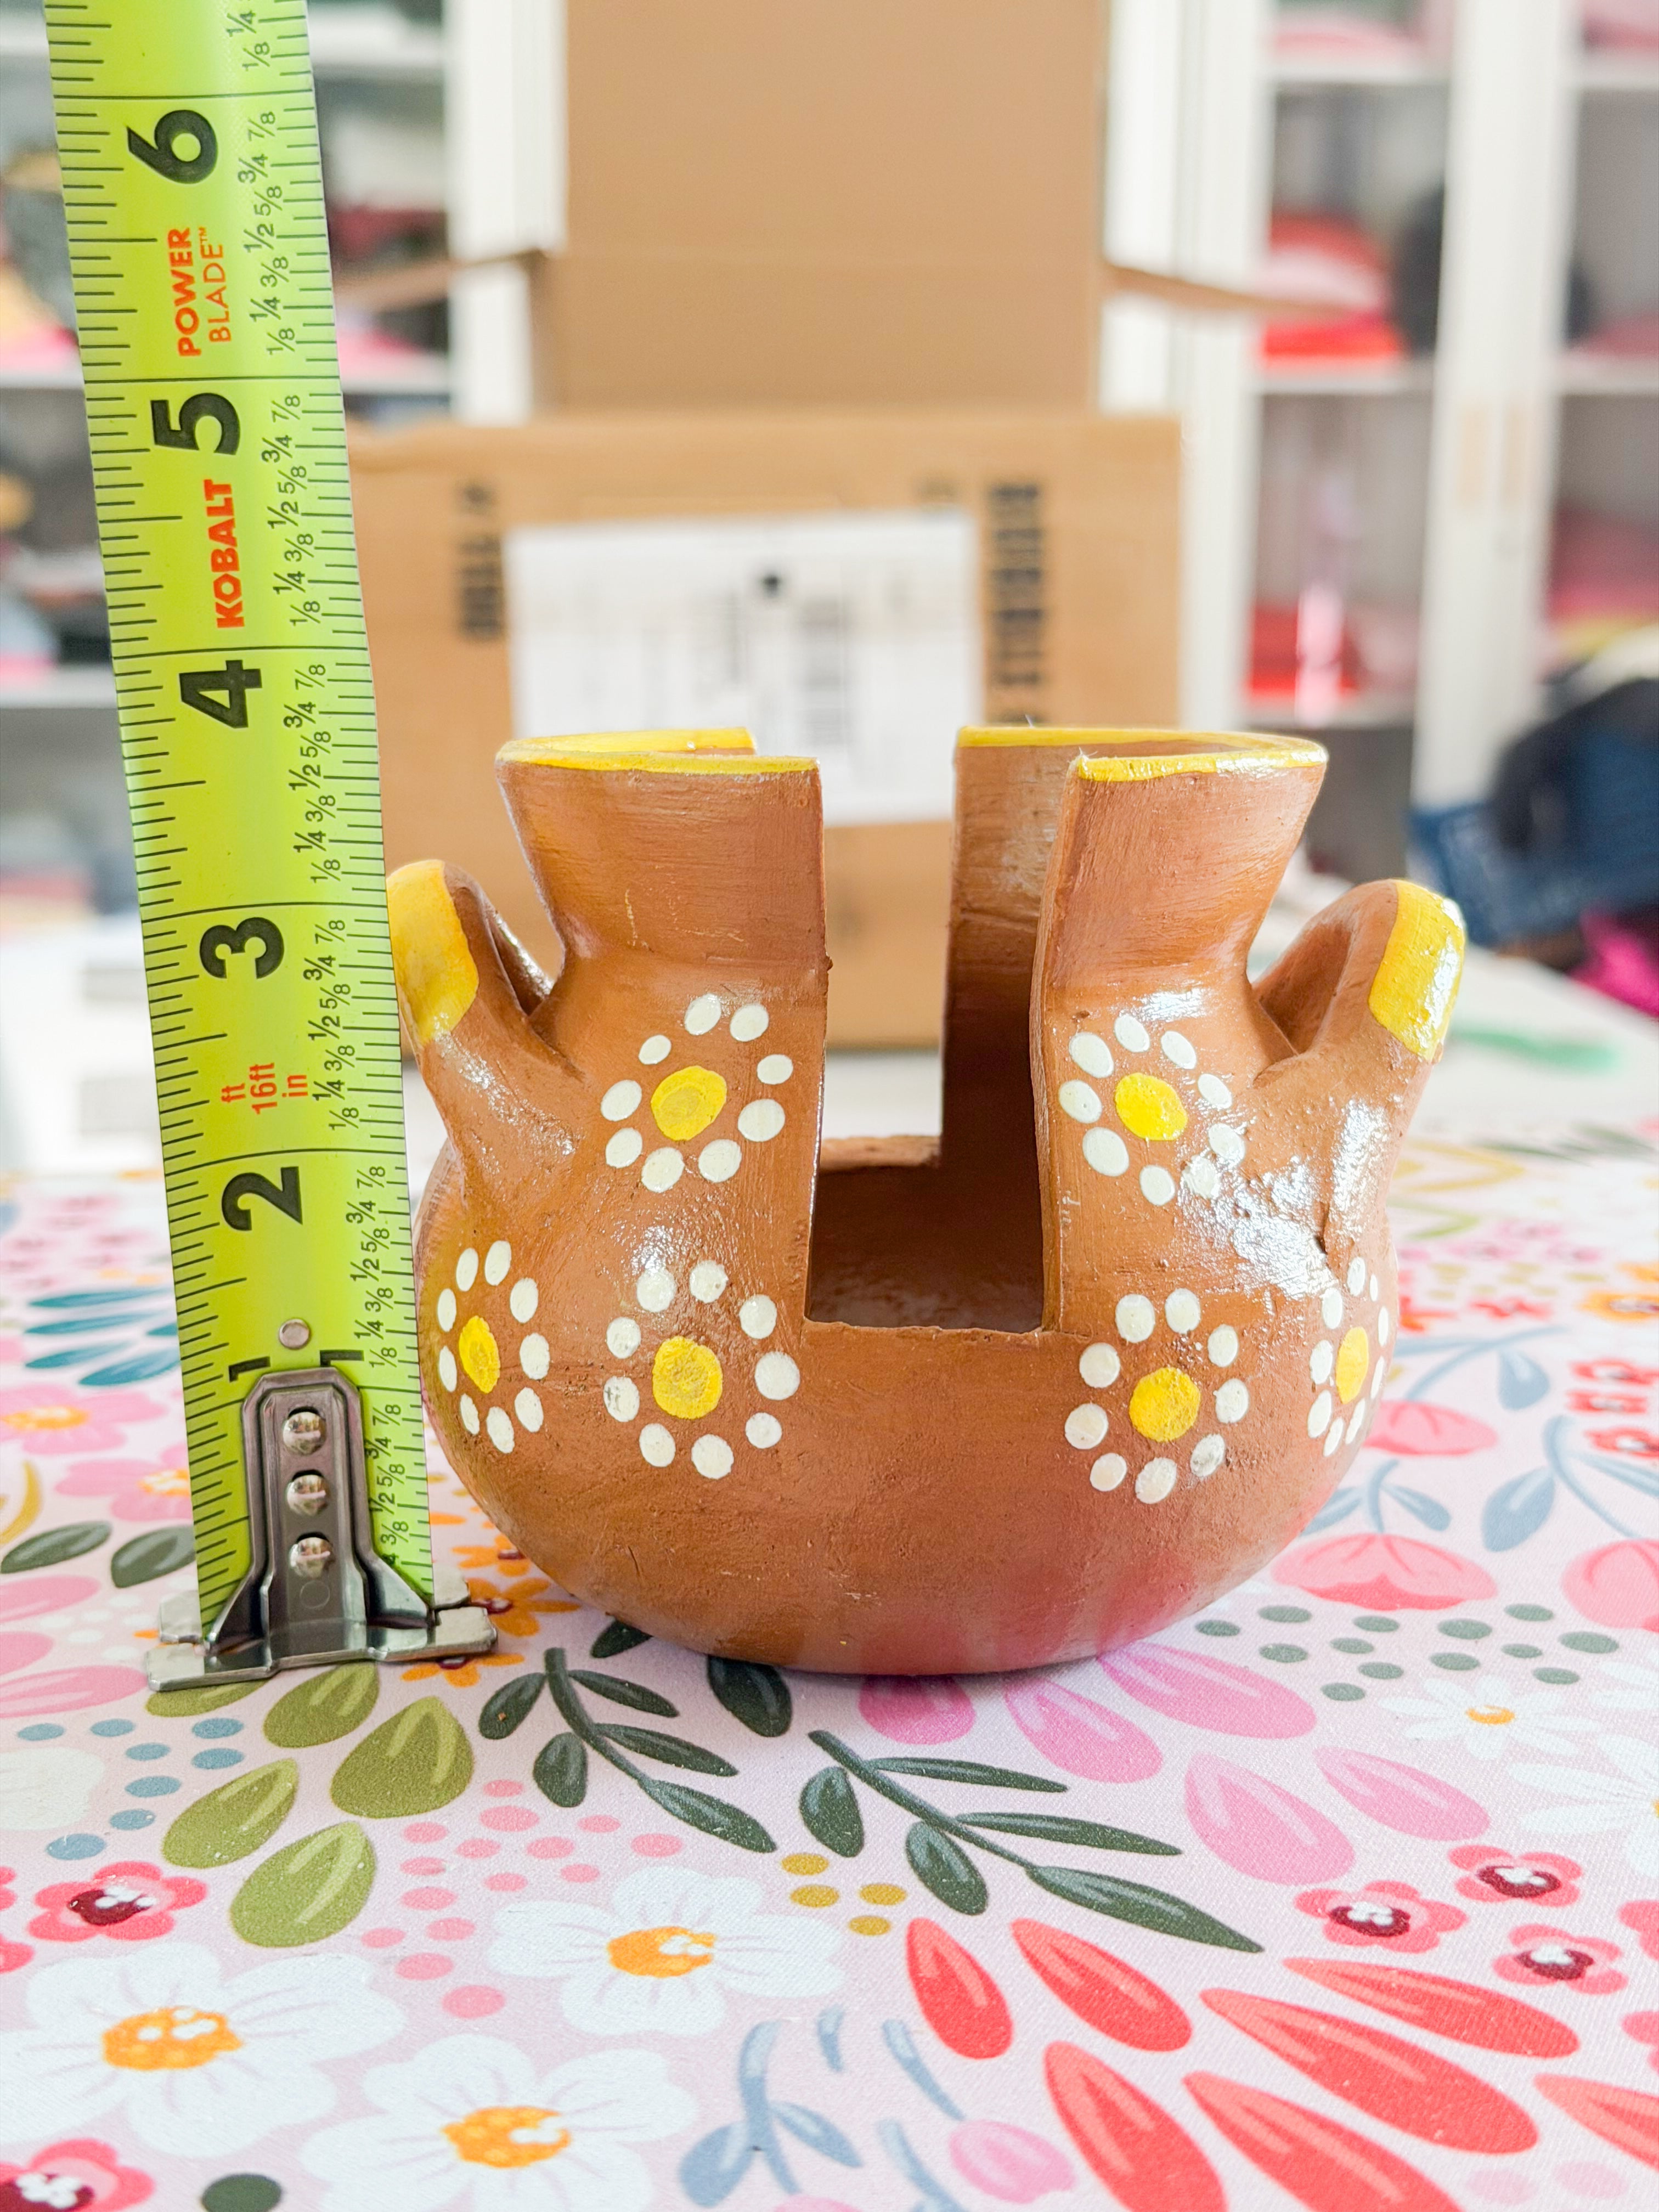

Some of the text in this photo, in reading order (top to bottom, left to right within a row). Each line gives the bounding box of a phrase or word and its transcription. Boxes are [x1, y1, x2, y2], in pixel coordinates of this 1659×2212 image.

[226, 10, 257, 37] 1/4
[242, 42, 270, 71] 1/8
[248, 111, 275, 140] 7/8
[127, 110, 218, 184] 6
[238, 154, 268, 184] 3/4
[253, 185, 283, 216] 5/8
[244, 223, 274, 253] 1/2
[261, 256, 289, 287] 3/8
[167, 228, 201, 357] POWER
[250, 296, 281, 322] 1/4
[267, 328, 295, 355] 1/8
[271, 394, 301, 423] 7/8
[150, 392, 241, 455] 5
[261, 435, 292, 463] 3/4
[278, 465, 307, 495] 5/8
[267, 501, 299, 529] 1/2
[204, 479, 245, 629] KOBALT
[285, 533, 314, 563] 3/8
[273, 571, 306, 595] 1/4
[290, 600, 321, 627] 1/8
[295, 664, 326, 690] 7/8
[179, 659, 262, 729] 4
[283, 701, 317, 728] 3/4
[300, 731, 331, 758] 5/8
[289, 764, 321, 791] 1/2
[306, 794, 336, 822] 3/8
[294, 831, 327, 853] 1/4
[310, 859, 341, 883] 1/8
[314, 919, 346, 944] 7/8
[199, 917, 285, 979] 3
[303, 956, 336, 981] 3/4
[319, 983, 351, 1009] 5/8
[308, 1015, 341, 1041] 1/2
[324, 1045, 356, 1071] 3/8
[221, 1083, 246, 1104] ft
[249, 1063, 278, 1115] 16ft
[281, 1075, 309, 1098] in
[312, 1079, 346, 1102] 1/4
[329, 1107, 359, 1131] 1/8
[357, 1166, 386, 1189] 7/8
[221, 1166, 303, 1231] 2
[346, 1200, 376, 1224] 3/4
[361, 1228, 390, 1253] 5/8
[349, 1259, 381, 1282] 1/2
[364, 1287, 394, 1313] 3/8
[354, 1320, 385, 1340] 1/4
[228, 1356, 270, 1382] 1
[369, 1347, 398, 1368] 1/8
[373, 1404, 402, 1426] 7/8
[377, 1463, 406, 1487] 5/8
[380, 1521, 409, 1545] 3/8
